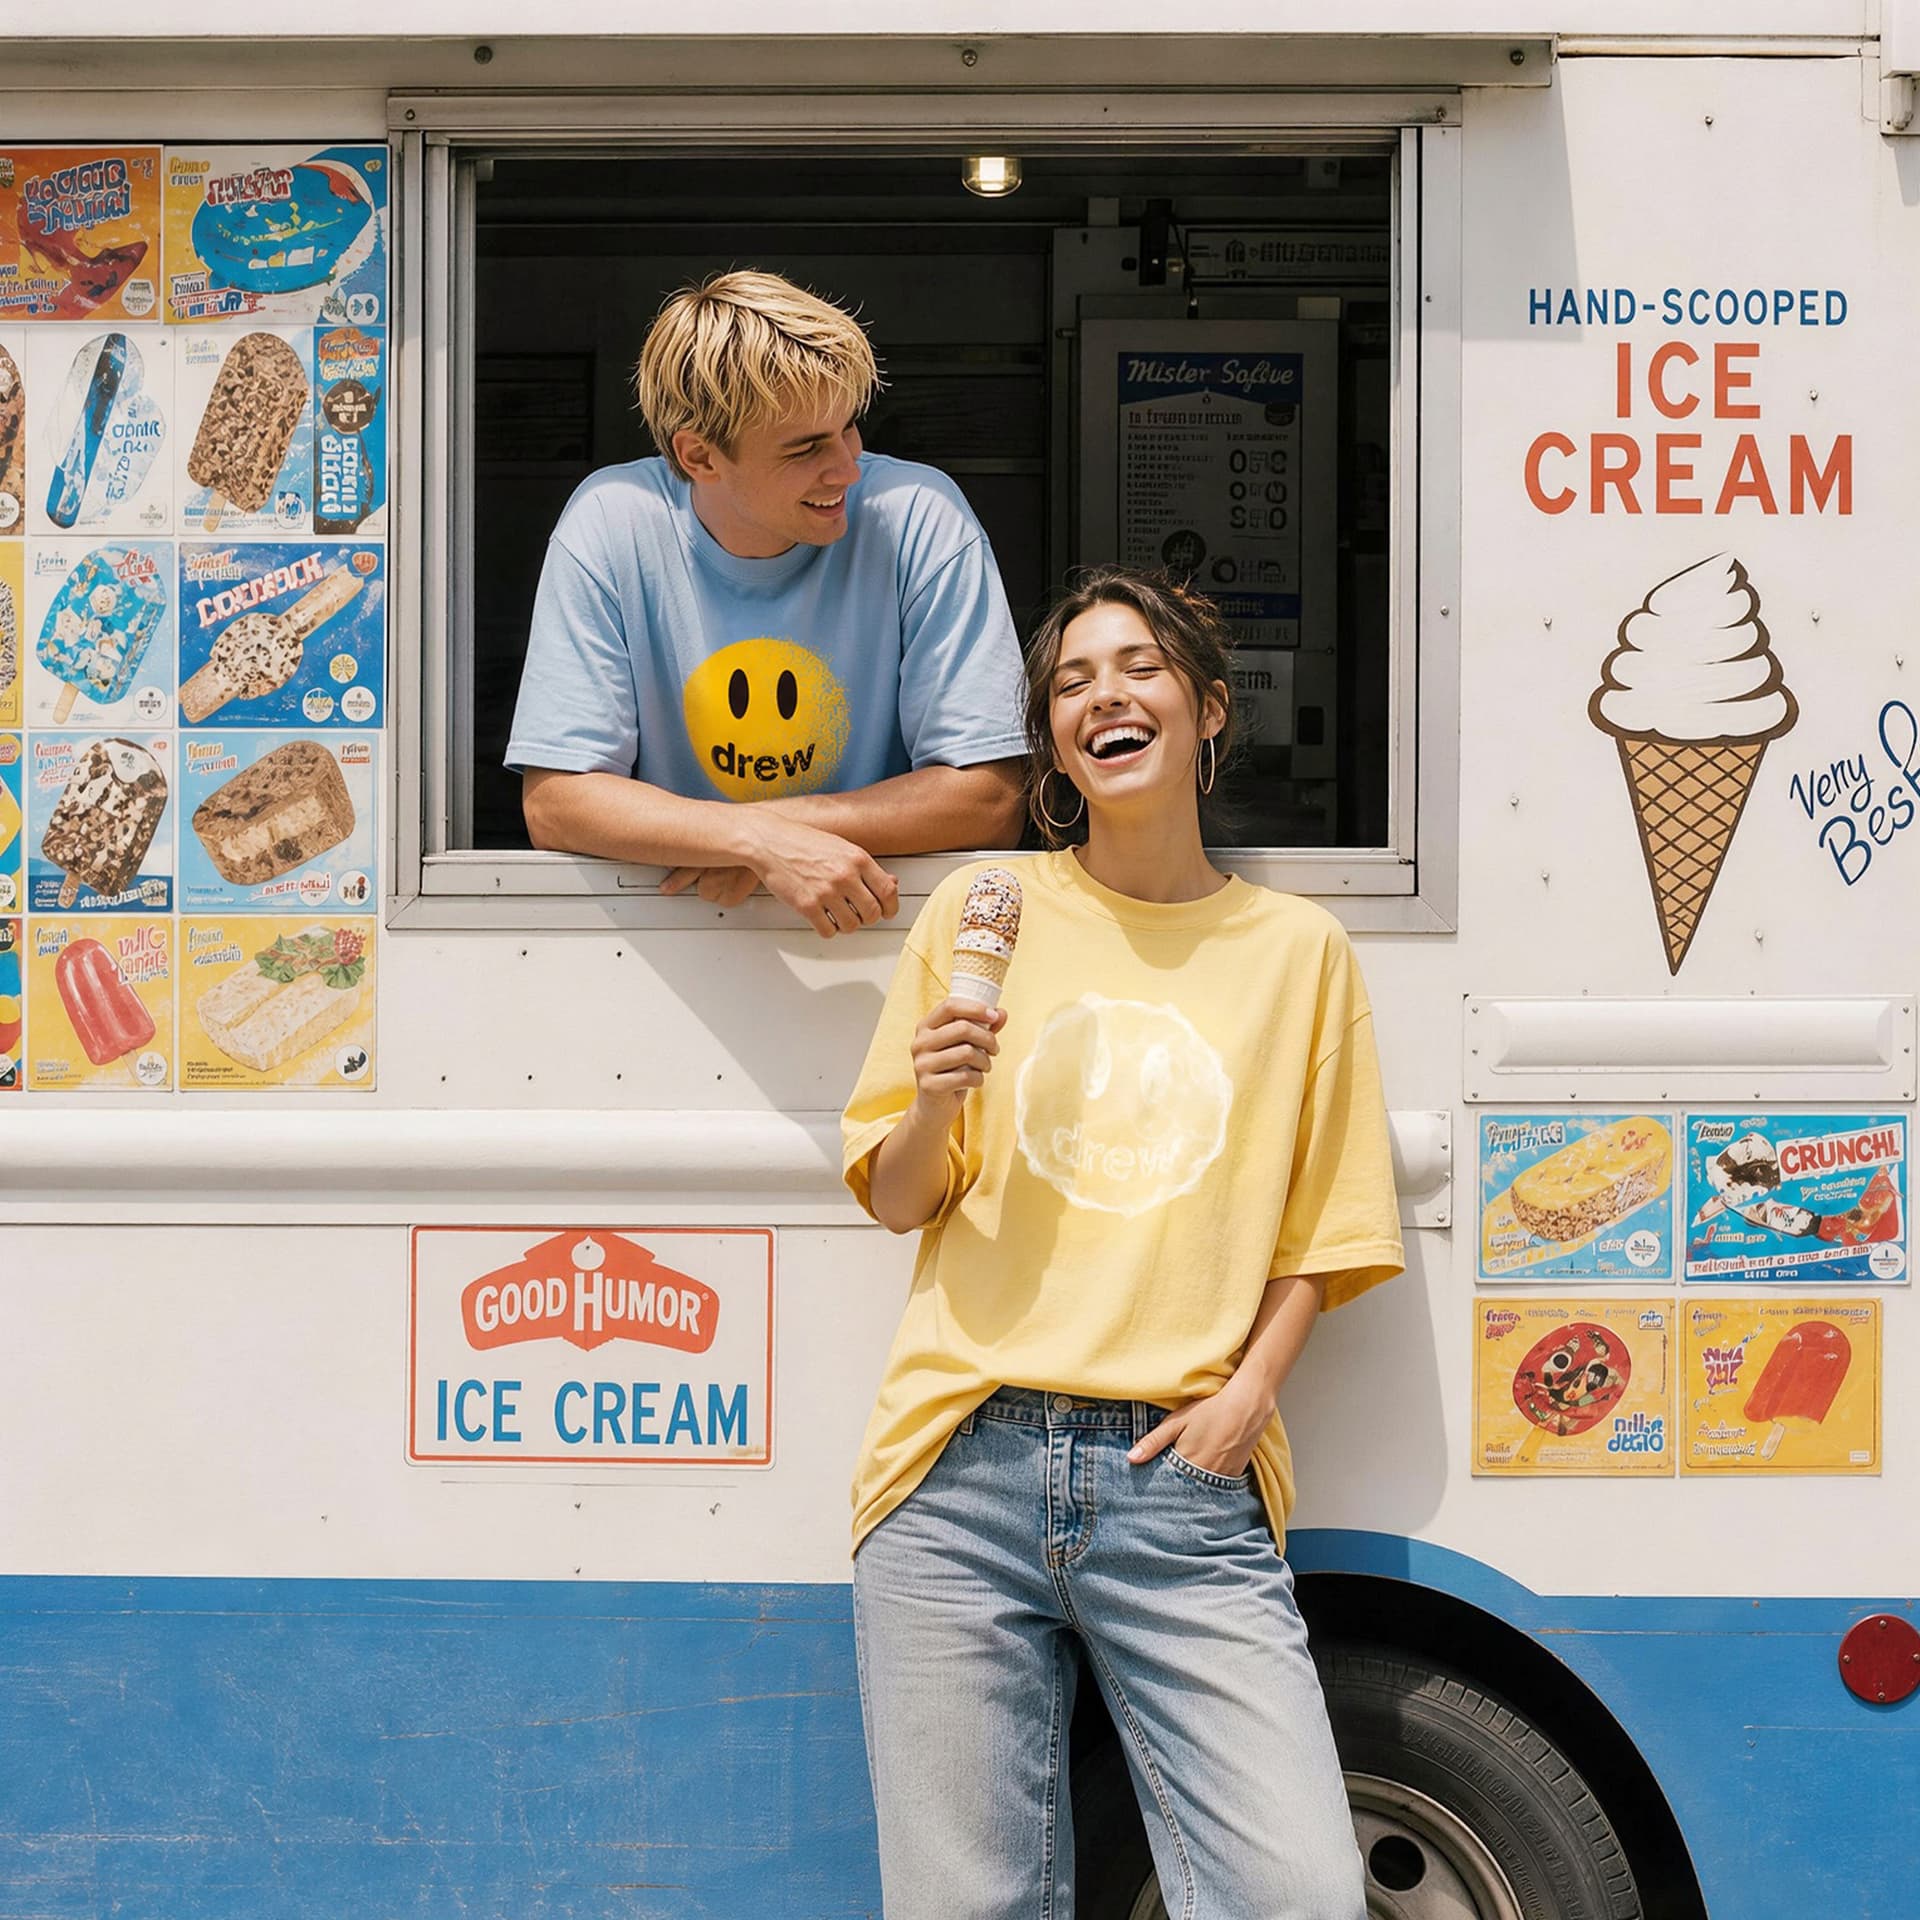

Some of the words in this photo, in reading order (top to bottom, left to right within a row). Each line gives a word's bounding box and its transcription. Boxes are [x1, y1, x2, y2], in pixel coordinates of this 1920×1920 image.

[1528, 288, 1849, 326] HAND-SCOOPED
[1616, 341, 1761, 419] ICE
[1524, 432, 1853, 515] CREAM
[711, 742, 816, 782] drew
[1052, 1122, 1185, 1182] drew
[474, 1277, 568, 1333] GOOD
[436, 1379, 523, 1443] ICE
[554, 1380, 749, 1446] CREAM
